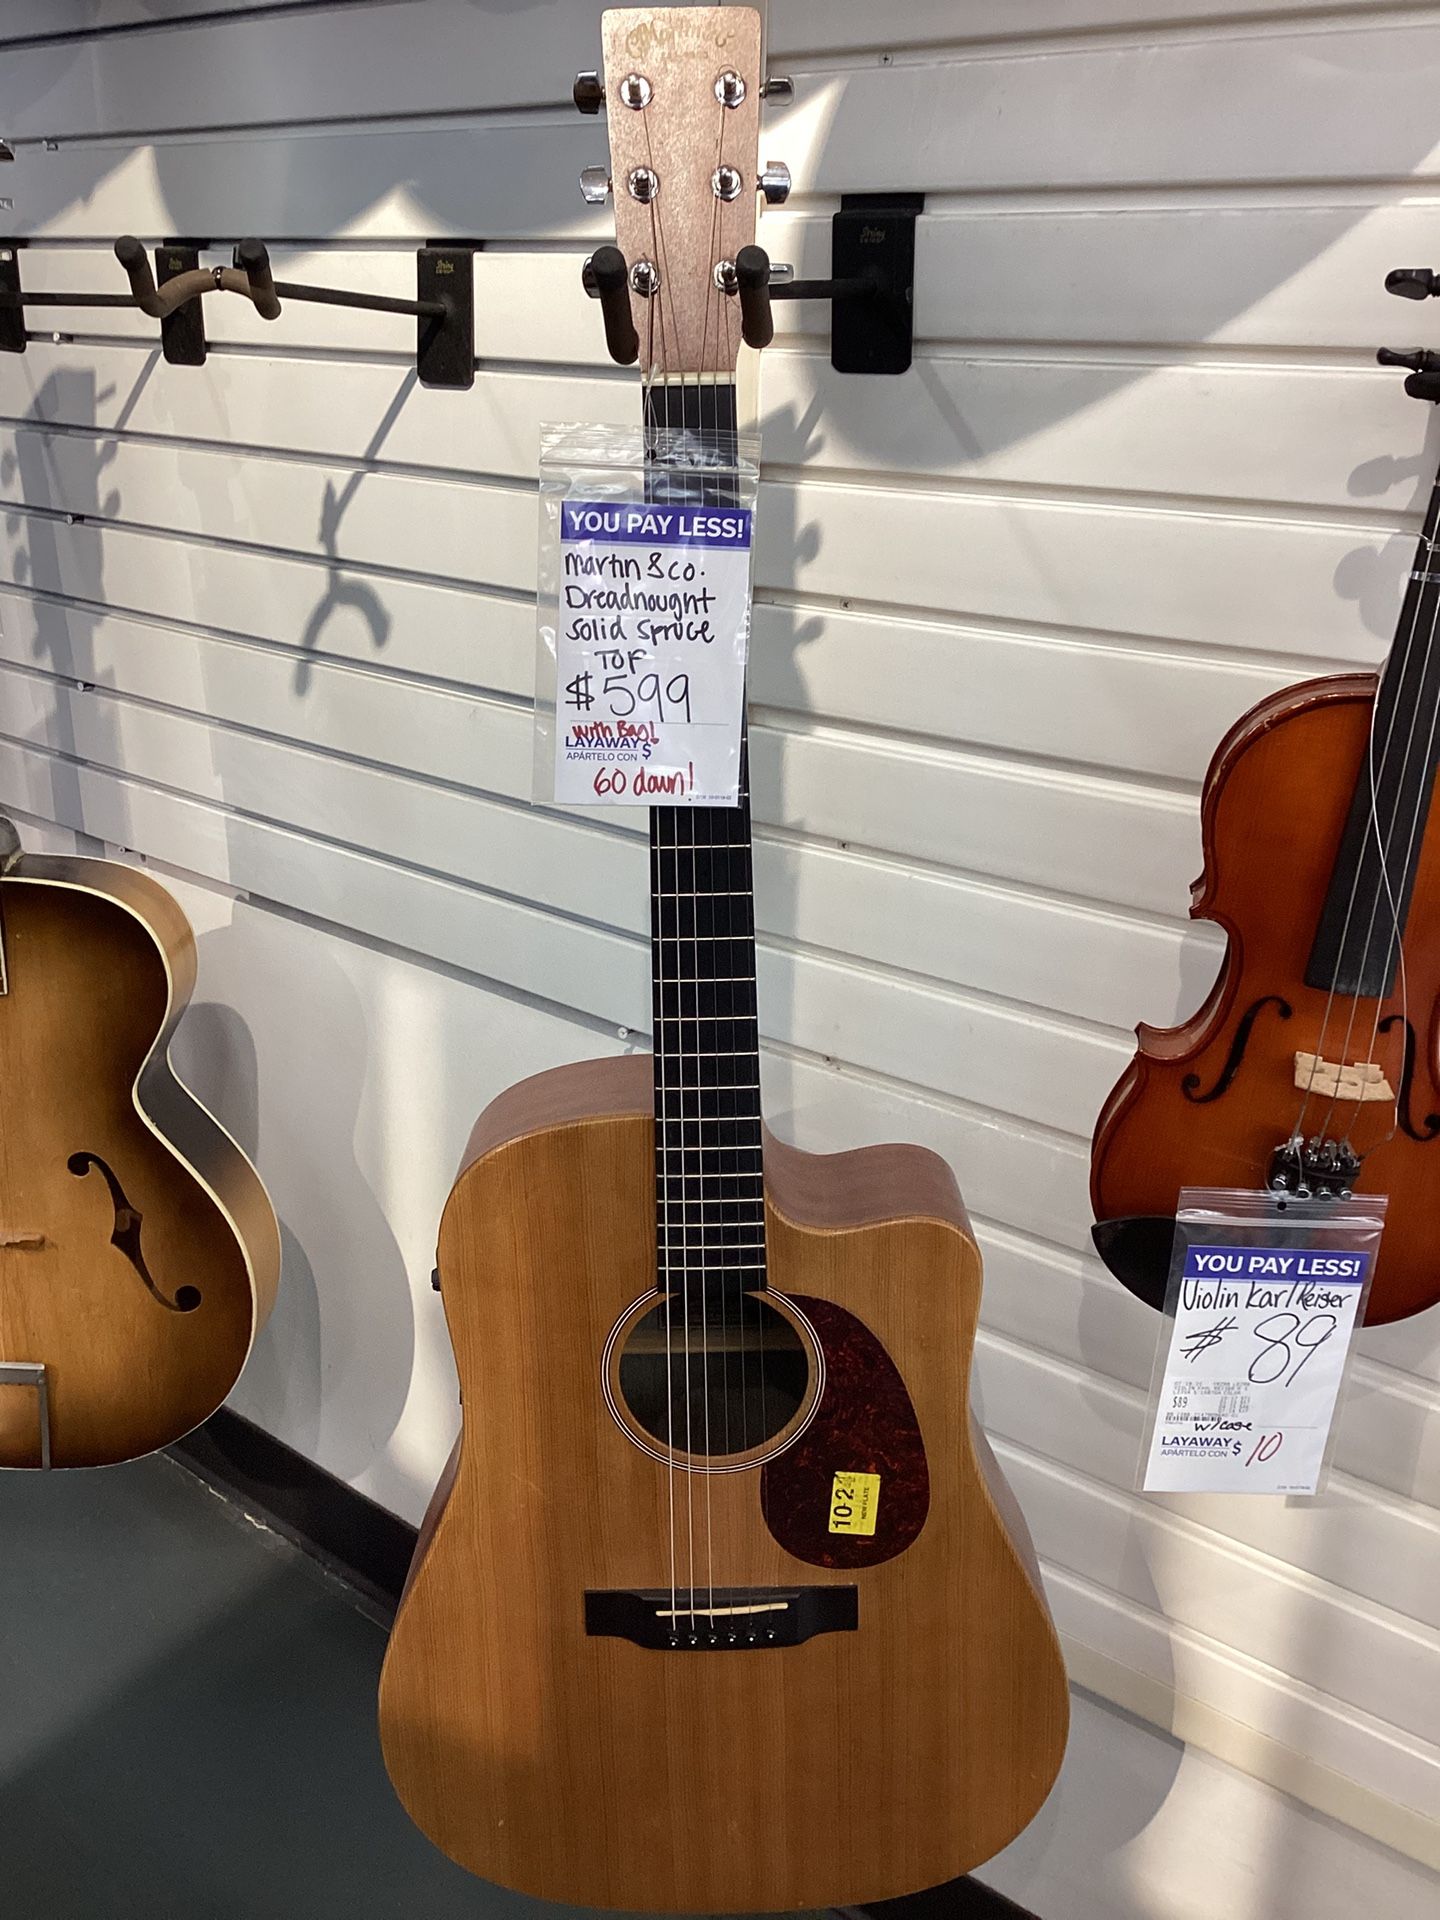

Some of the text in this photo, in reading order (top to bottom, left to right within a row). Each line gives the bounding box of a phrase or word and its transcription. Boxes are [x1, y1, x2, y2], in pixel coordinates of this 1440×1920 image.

[569, 511, 744, 538] YOU PAY LESS!
[565, 736, 639, 748] LAYAWAY
[566, 751, 638, 761] APÁRTELO CON
[594, 761, 694, 802] 60 down!
[1194, 1254, 1361, 1277] YOU PAY LESS!
[1183, 1278, 1239, 1311] Violin
[1161, 1436, 1233, 1447] LAYAWAY
[1160, 1448, 1228, 1458] APÁRTELO CON
